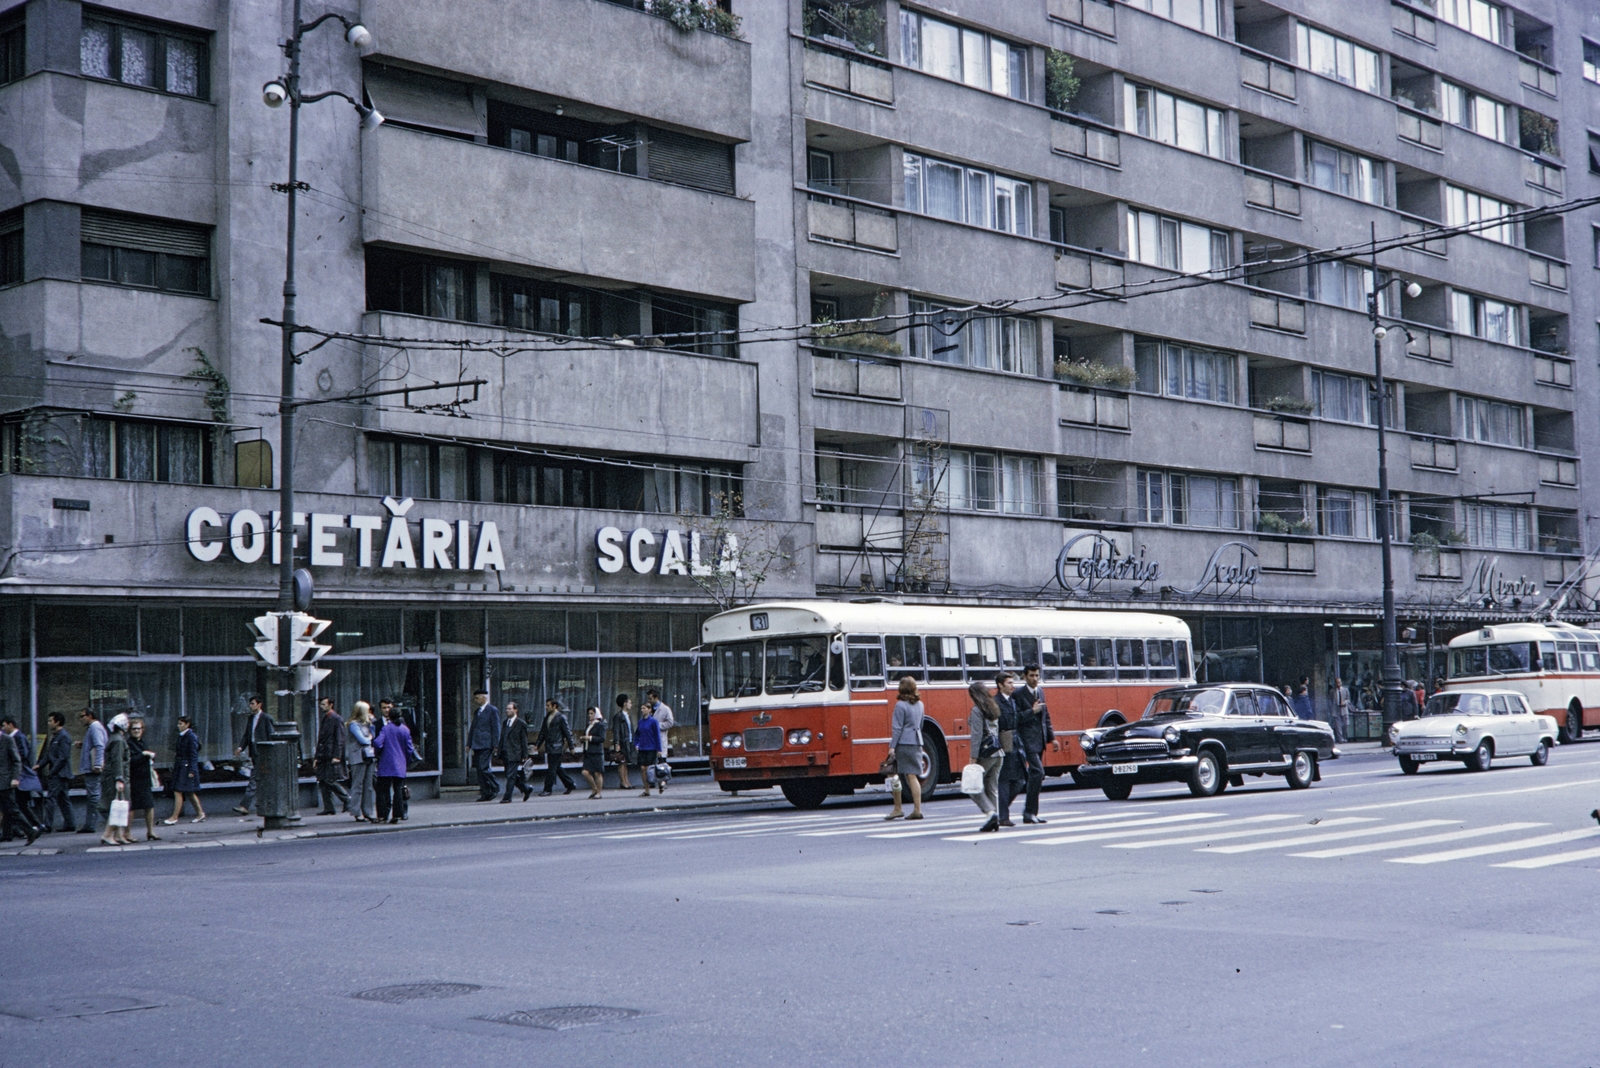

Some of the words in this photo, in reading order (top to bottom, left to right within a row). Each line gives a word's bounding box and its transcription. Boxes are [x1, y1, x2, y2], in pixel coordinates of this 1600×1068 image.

[187, 496, 506, 571] COFETĂRIA
[595, 526, 743, 577] SCALA
[1169, 541, 1260, 594] Scala
